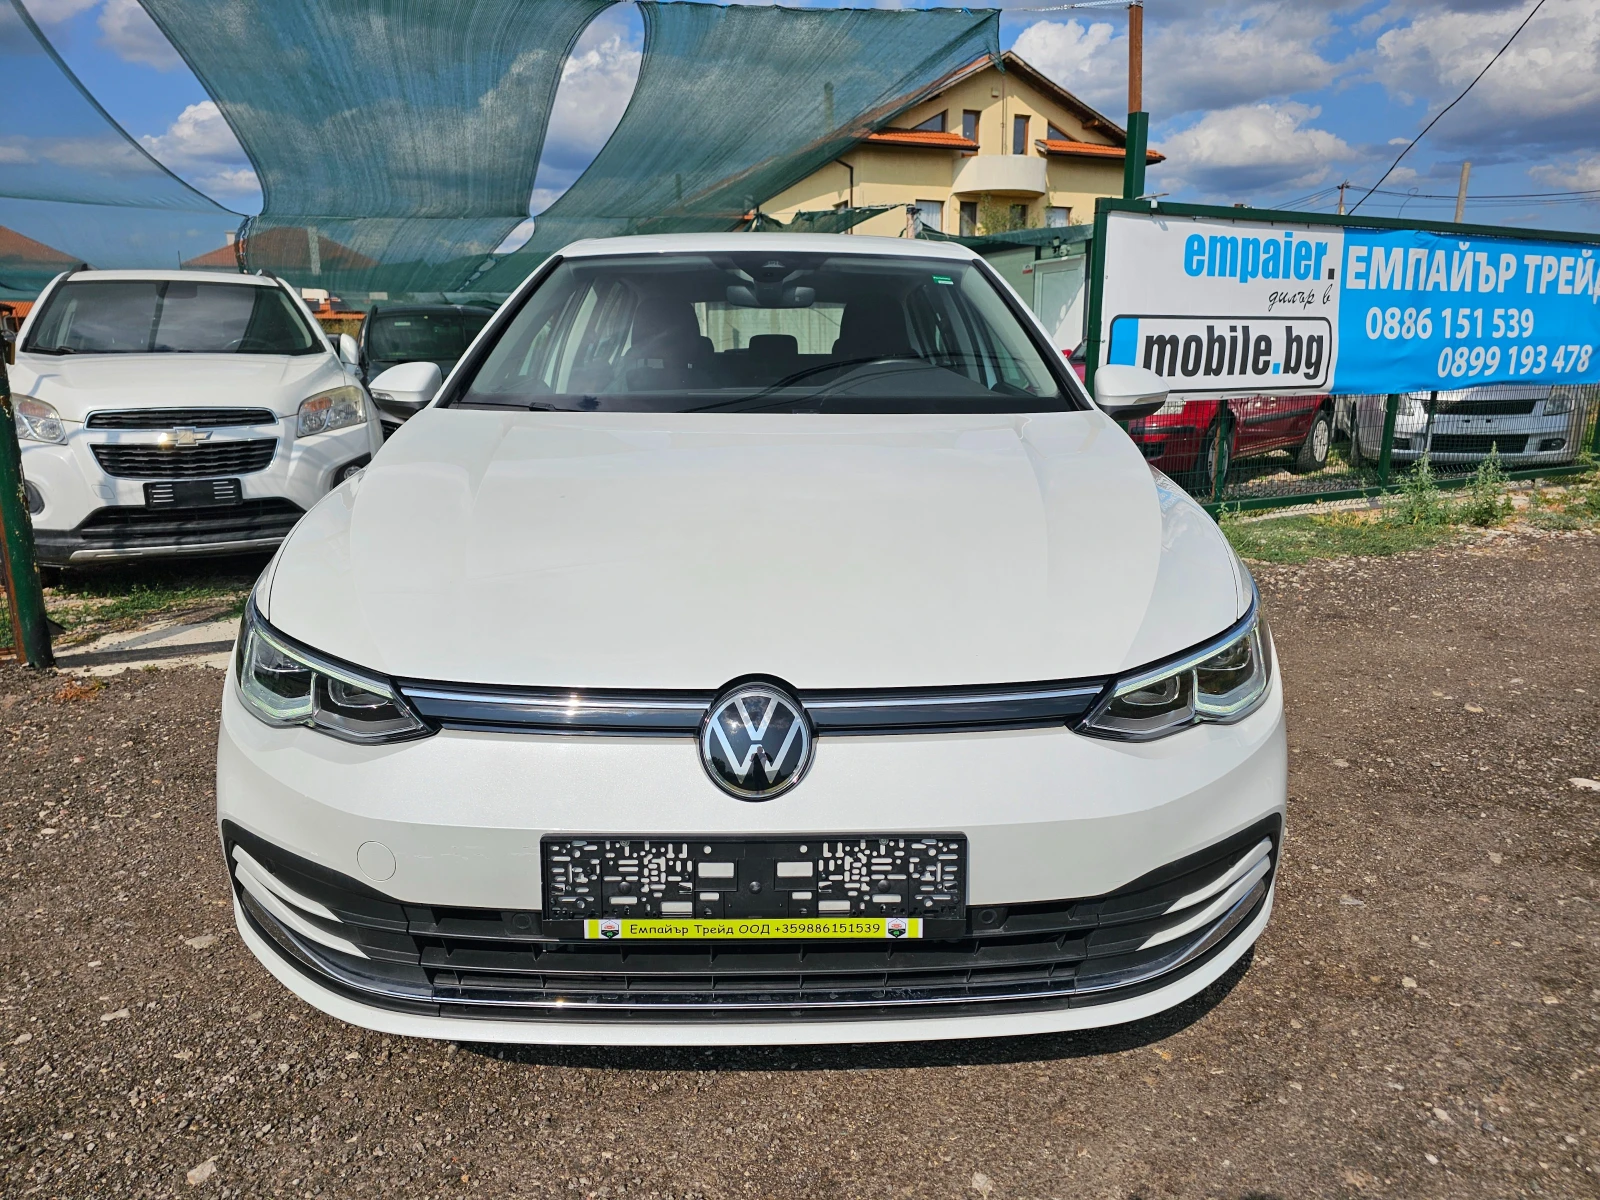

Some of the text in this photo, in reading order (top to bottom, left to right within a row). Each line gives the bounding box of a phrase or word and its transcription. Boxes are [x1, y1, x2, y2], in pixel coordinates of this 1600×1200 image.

[1184, 231, 1335, 283] empaier.
[1346, 241, 1517, 293] ЕМПАЙЪР
[1268, 288, 1315, 312] дилър
[1365, 306, 1535, 340] 0886 151 539
[1143, 325, 1324, 380] mobile.bg
[1437, 344, 1593, 378] 0899 193 478
[629, 923, 881, 936] Емпайър Трейд ООД +359886151539
